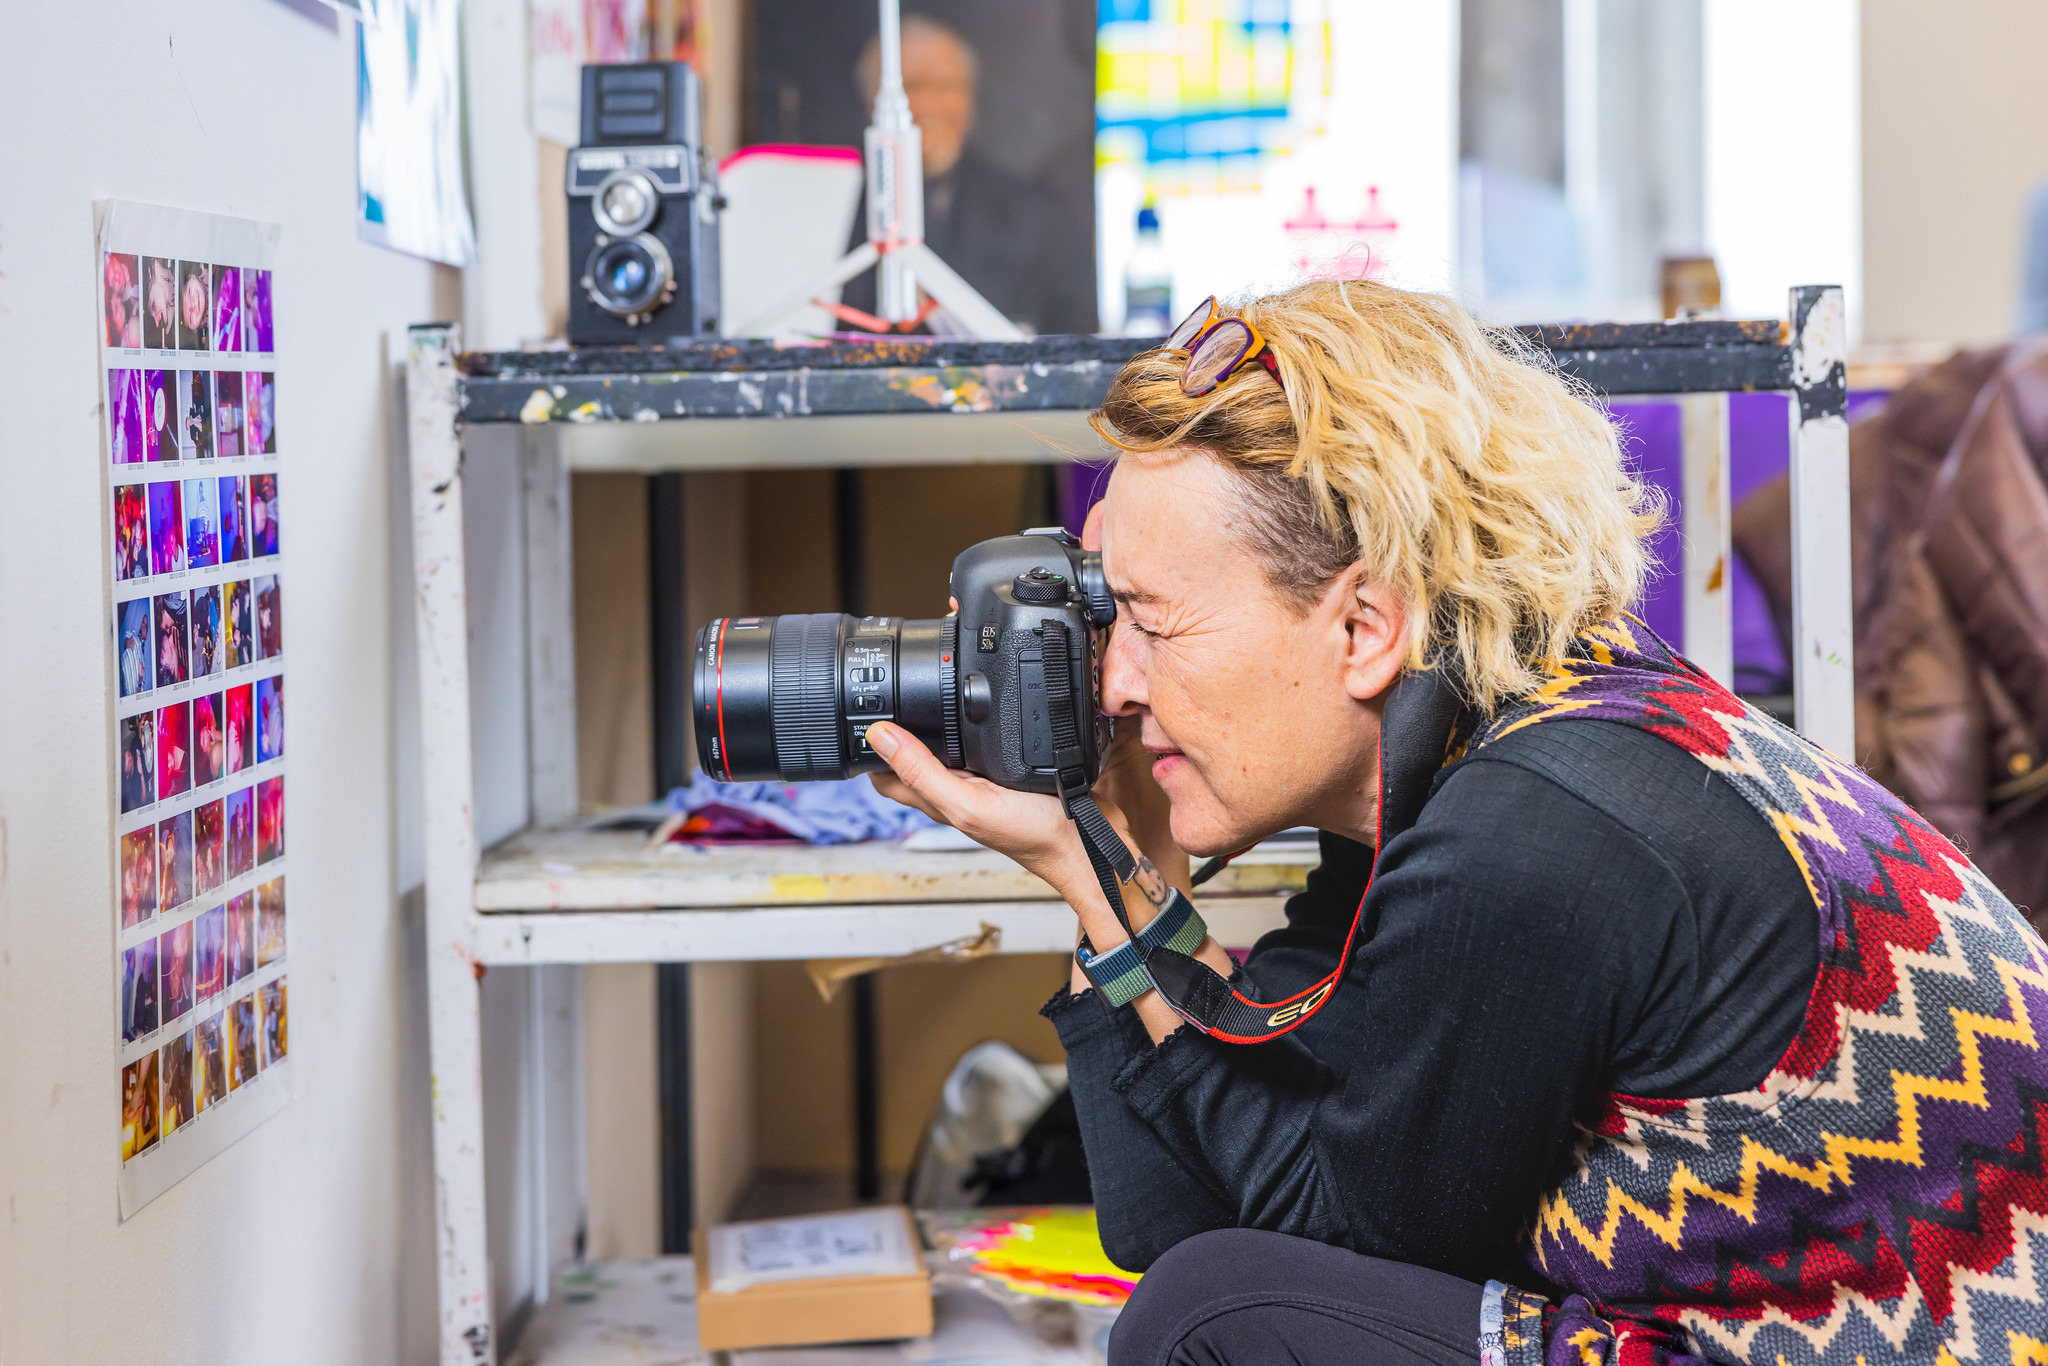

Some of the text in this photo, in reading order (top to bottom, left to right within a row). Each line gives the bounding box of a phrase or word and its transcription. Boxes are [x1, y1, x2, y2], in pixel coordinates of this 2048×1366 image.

[982, 626, 996, 638] EOS
[708, 643, 716, 666] CANON
[1266, 982, 1333, 1027] EO
